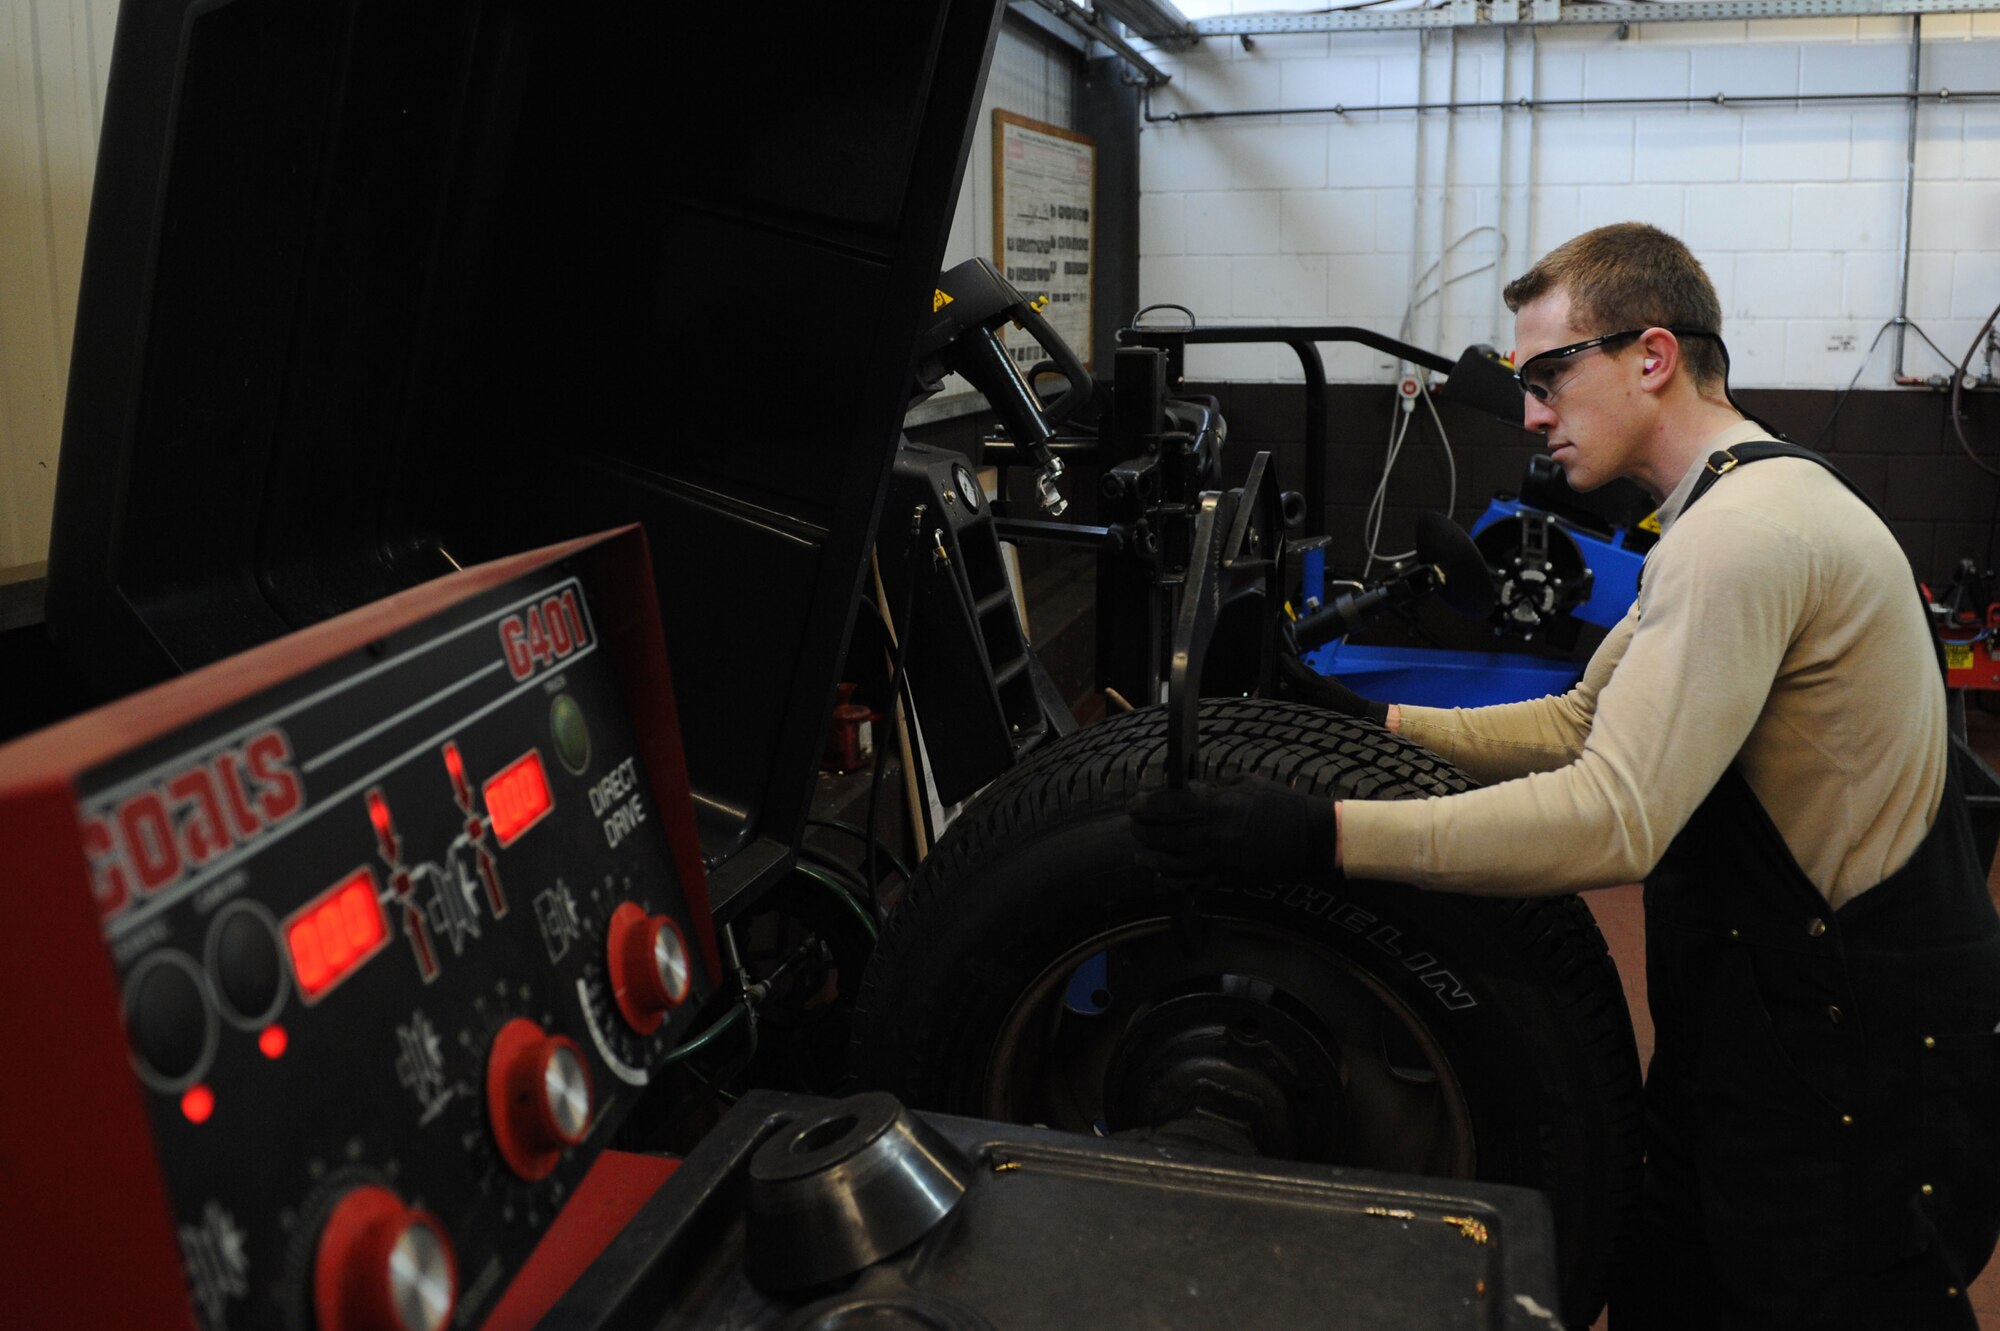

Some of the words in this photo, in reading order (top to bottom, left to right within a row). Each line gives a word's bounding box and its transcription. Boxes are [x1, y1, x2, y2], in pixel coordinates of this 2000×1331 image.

[588, 756, 638, 818] DIRECT
[603, 793, 647, 848] DRIVE
[1217, 884, 1478, 1011] HELIN
